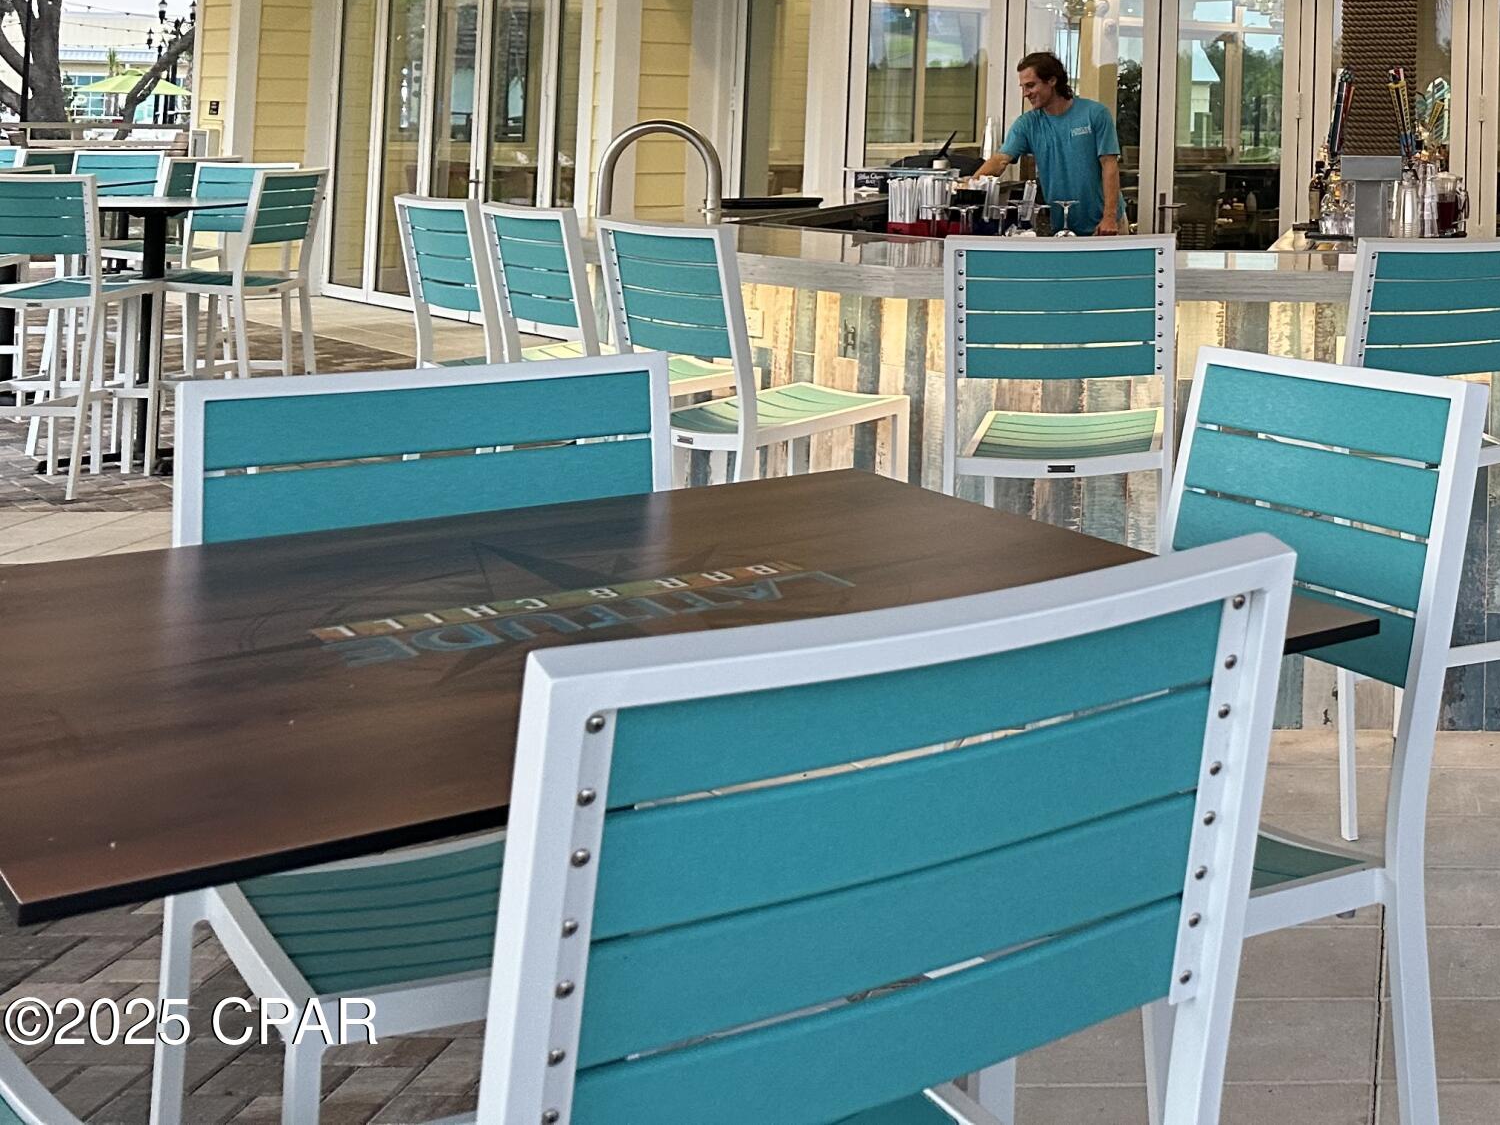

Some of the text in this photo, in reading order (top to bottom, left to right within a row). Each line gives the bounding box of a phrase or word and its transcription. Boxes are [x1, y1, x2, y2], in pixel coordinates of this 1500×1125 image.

[320, 570, 856, 667] LATITUDE
[324, 564, 779, 638] BAR & CHILL
